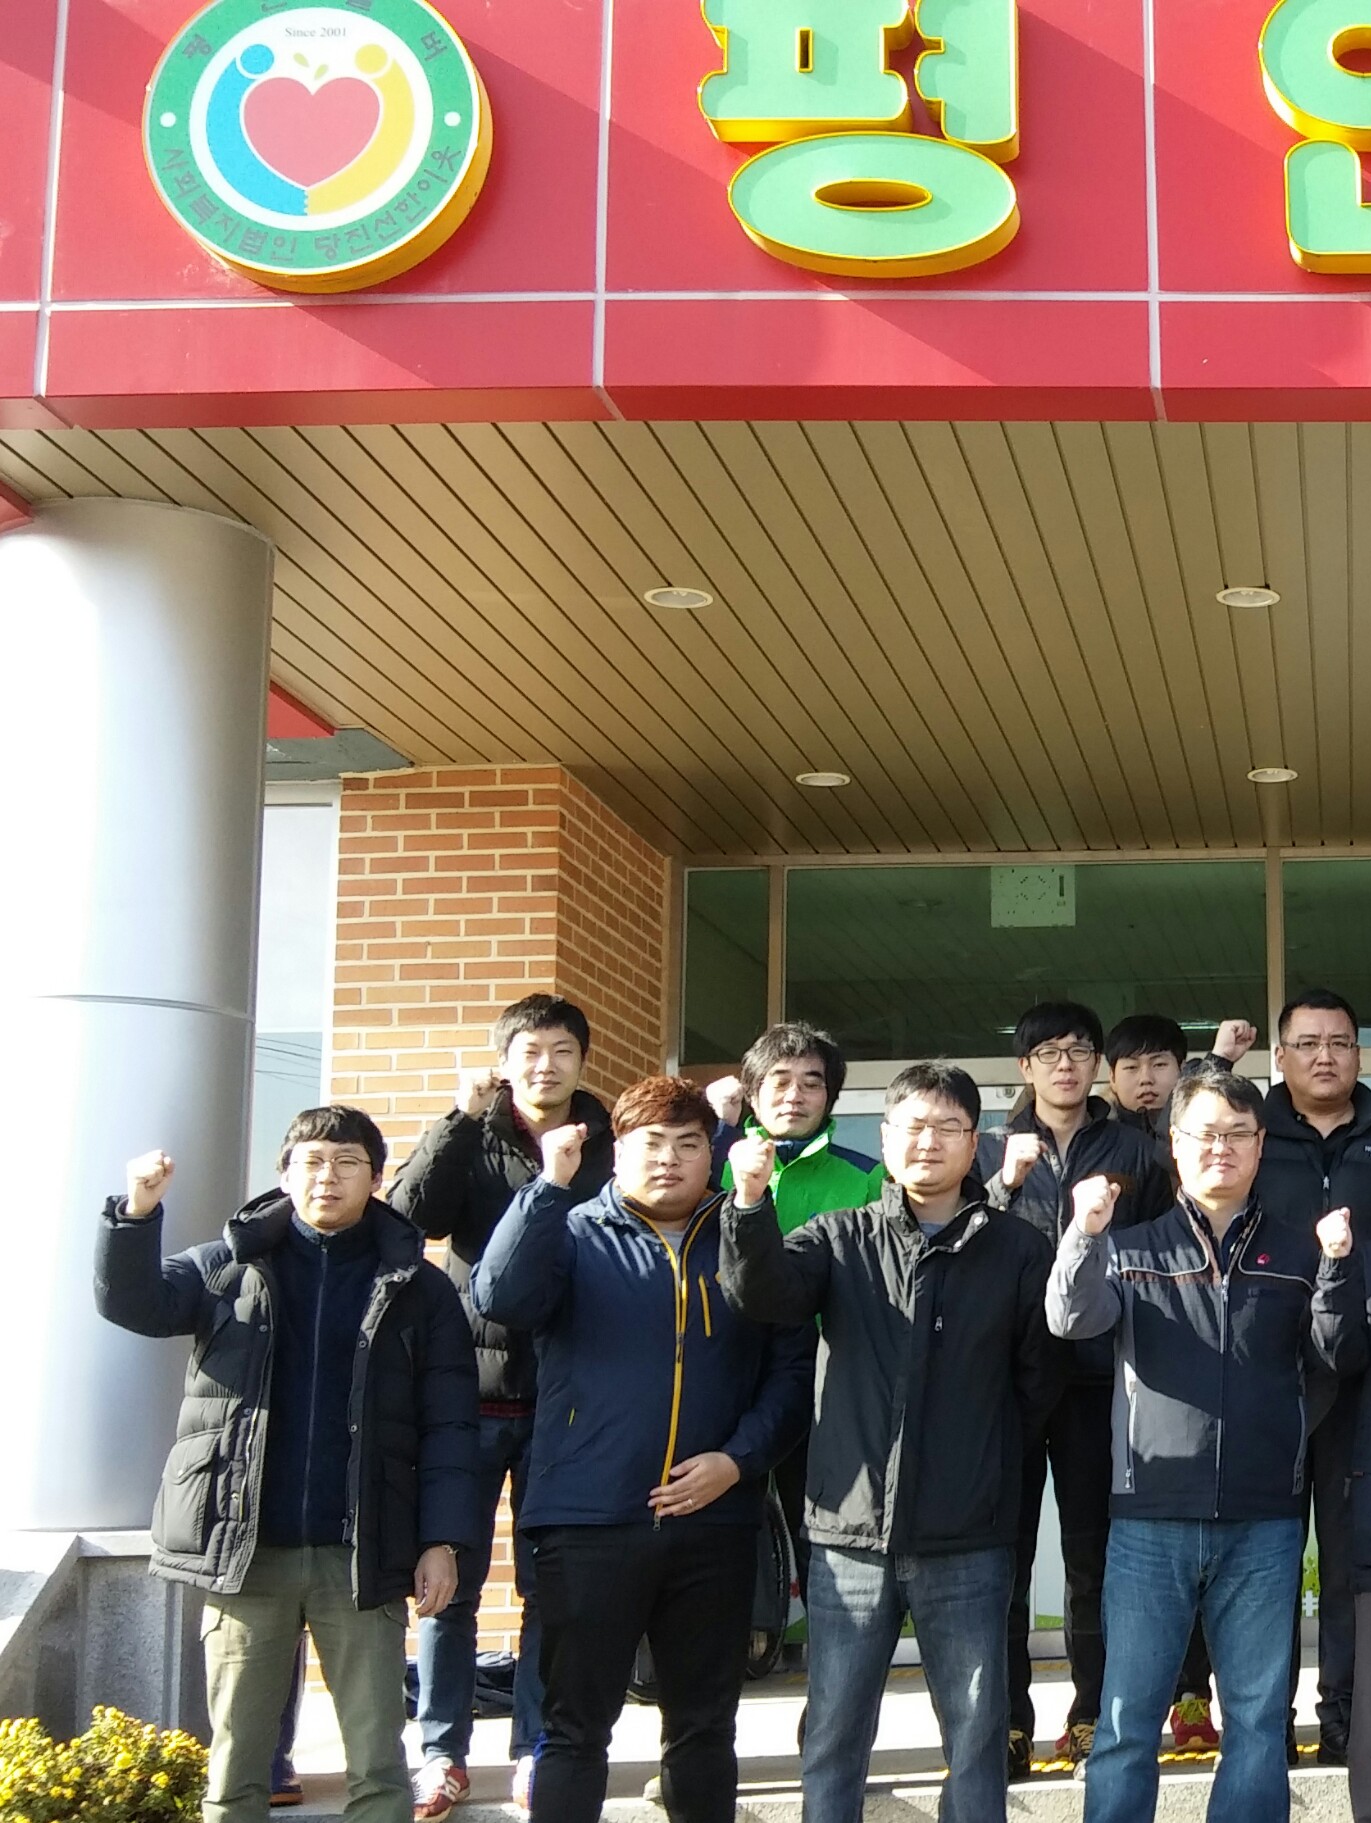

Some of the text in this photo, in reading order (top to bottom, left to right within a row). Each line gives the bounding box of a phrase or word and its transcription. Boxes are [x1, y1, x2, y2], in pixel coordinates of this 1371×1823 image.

[284, 26, 347, 38] Since 2001
[161, 145, 463, 262] 사회복지법인 당진선한이웃
